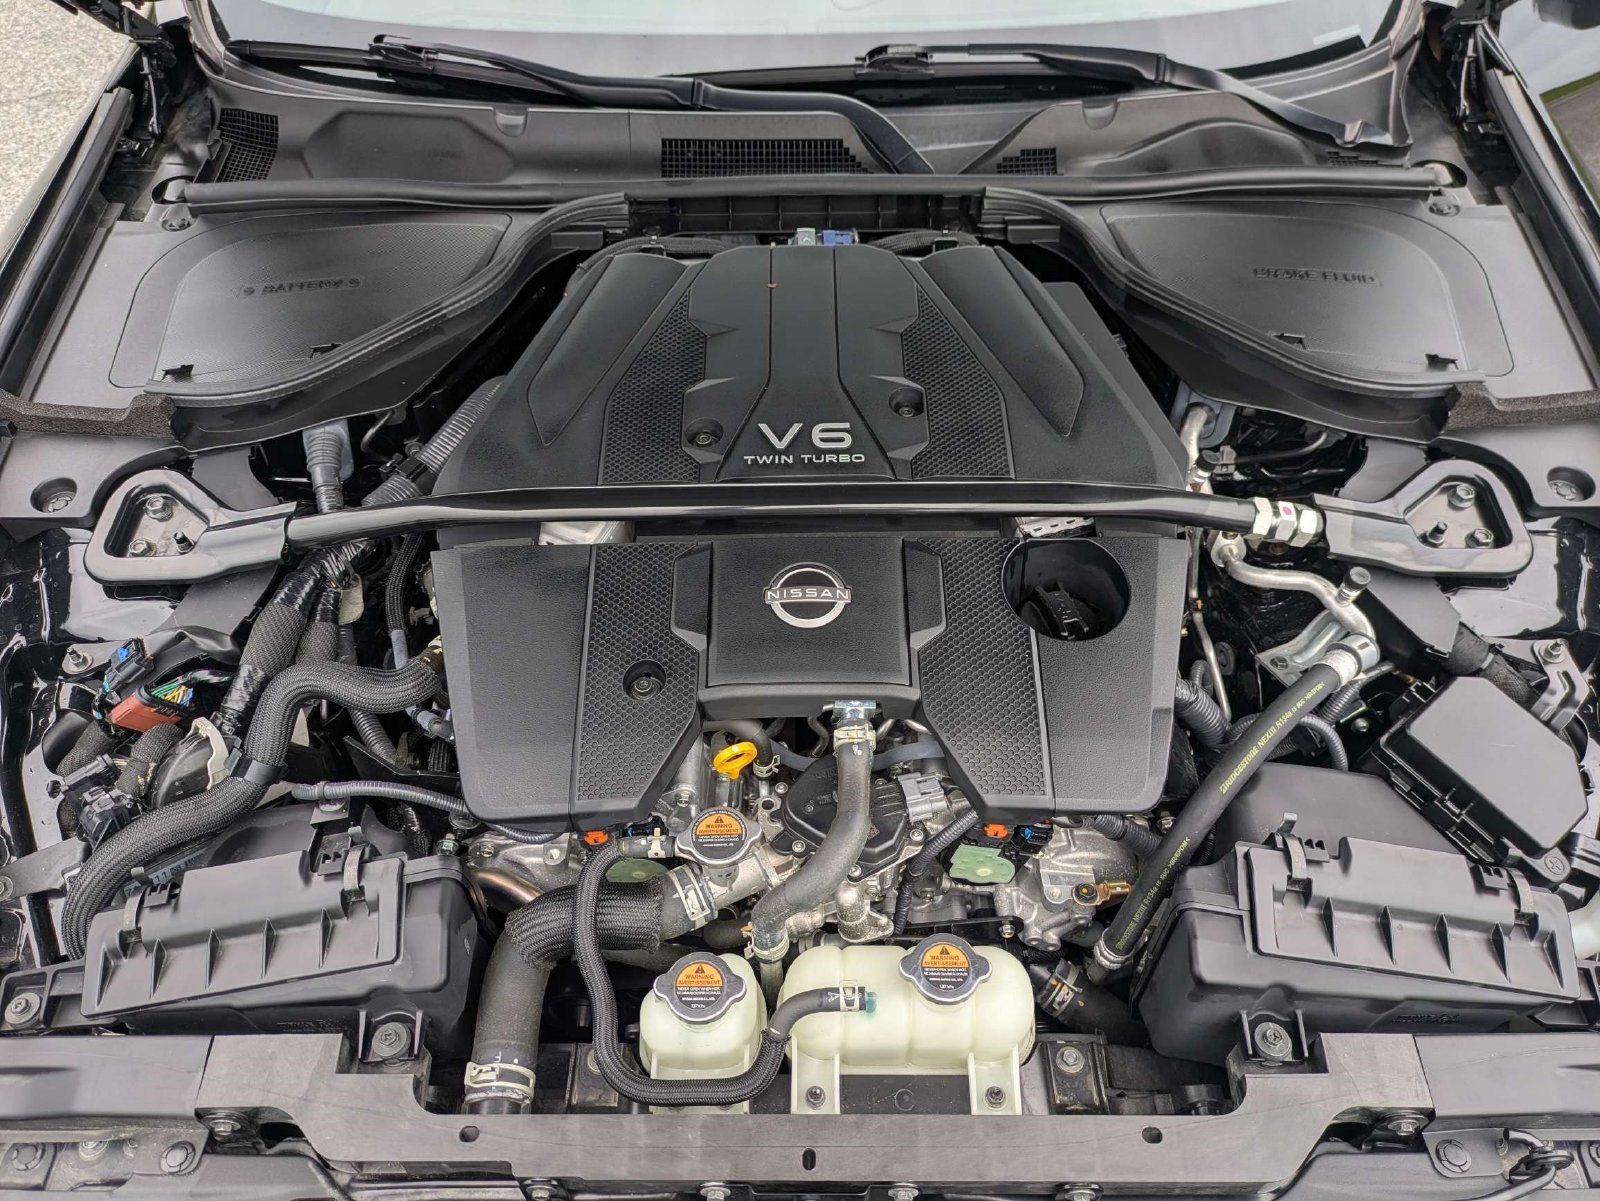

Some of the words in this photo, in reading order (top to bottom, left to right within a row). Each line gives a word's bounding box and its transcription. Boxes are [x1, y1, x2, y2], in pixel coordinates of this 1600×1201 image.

[1322, 271, 1376, 284] FLUID
[262, 279, 343, 295] BATTERY
[757, 422, 852, 449] V6
[743, 455, 793, 464] TWIN
[801, 454, 865, 463] TURBO
[767, 588, 849, 600] NISSAN
[1220, 745, 1259, 794] BRIDGESTONE
